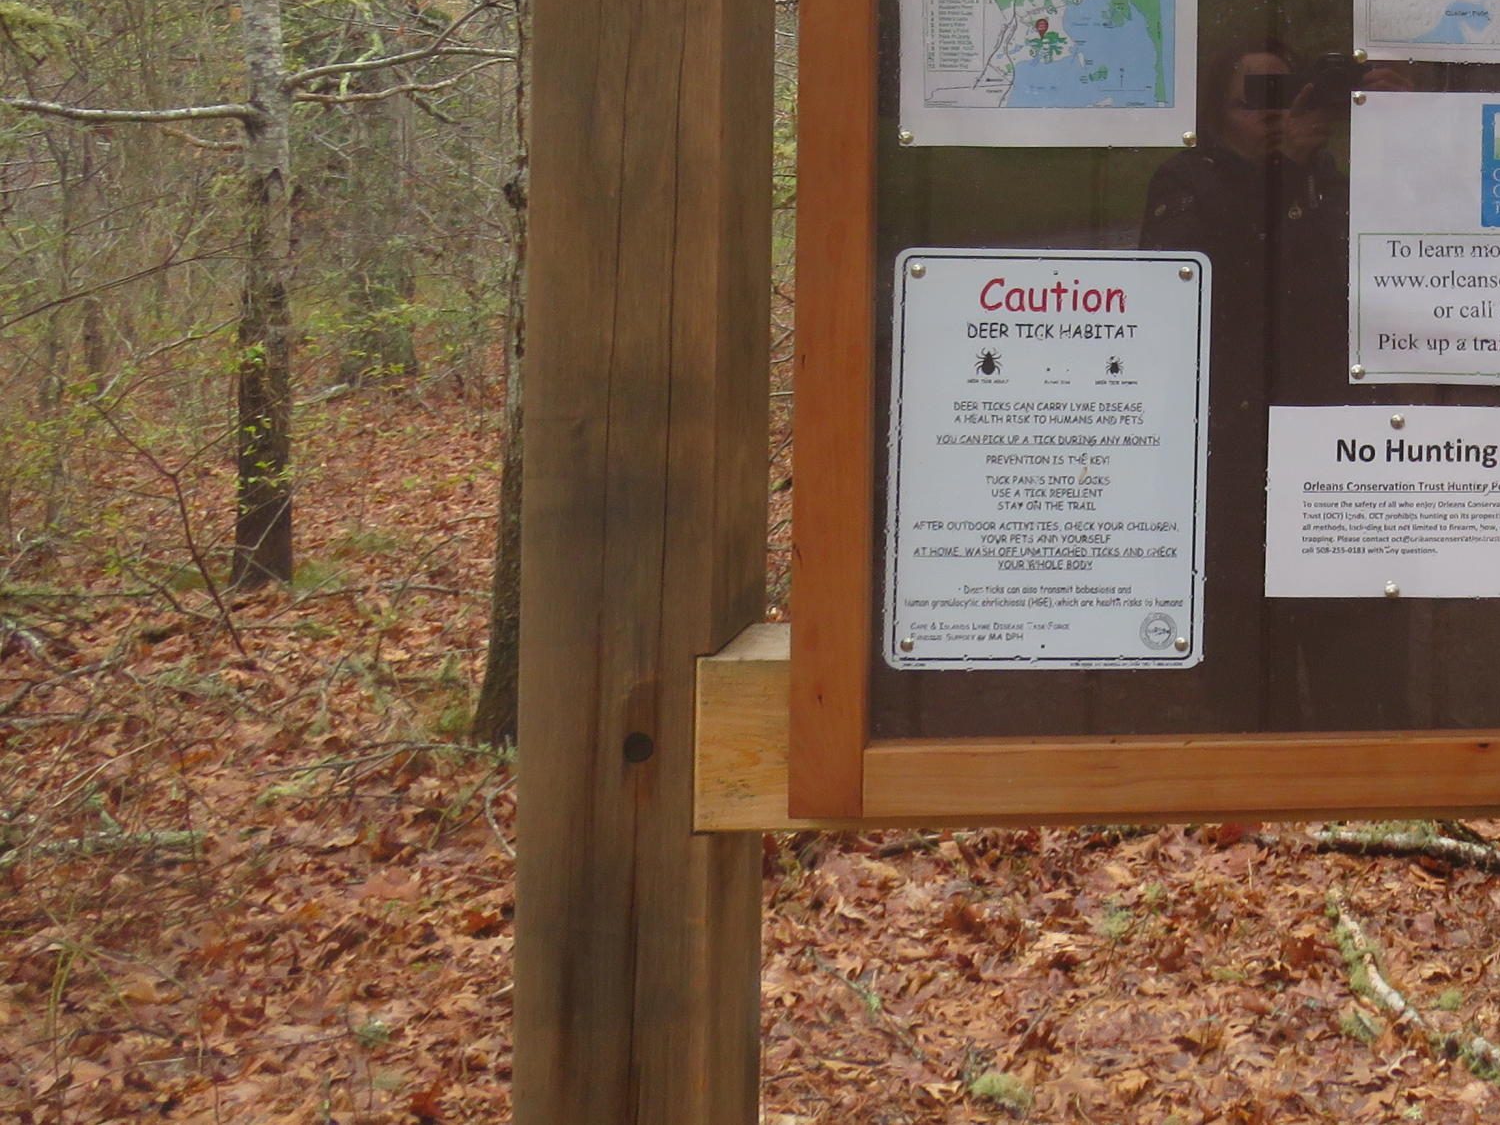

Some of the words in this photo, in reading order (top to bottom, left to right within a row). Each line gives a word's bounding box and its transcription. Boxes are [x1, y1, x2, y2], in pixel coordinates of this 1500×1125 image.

[1387, 240, 1411, 258] To
[1419, 240, 1464, 258] learn
[980, 278, 1127, 314] Caution
[1433, 305, 1454, 319] or
[1460, 300, 1493, 319] call
[967, 323, 1009, 340] DEER
[1016, 323, 1054, 340] TICK
[1059, 323, 1138, 340] HABITAT
[1378, 334, 1418, 351] Pick
[1427, 338, 1449, 355] up
[1456, 339, 1466, 351] a
[953, 401, 978, 412] DEER
[981, 401, 1011, 412] TICKS
[1013, 401, 1034, 412] CAN
[1036, 401, 1067, 412] CARRY
[1070, 401, 1096, 412] LYME
[1098, 401, 1145, 412] DISEASE,
[954, 414, 961, 425] A
[964, 414, 1003, 425] HEALTH
[1006, 414, 1030, 425] RISK
[1034, 414, 1047, 425] TO
[1049, 414, 1093, 425] HUMANS
[1096, 414, 1117, 425] AND
[1120, 414, 1144, 425] PETS
[936, 434, 957, 445] YOU
[960, 434, 981, 445] CAN
[983, 434, 1006, 445] PICK
[1007, 434, 1019, 445] UP
[1023, 434, 1029, 445] A
[1032, 434, 1055, 445] TICK
[1058, 434, 1097, 445] DURING
[1100, 434, 1120, 445] ANY
[1123, 434, 1160, 445] MONTH
[1336, 439, 1376, 462] No
[1386, 438, 1498, 468] Hunting
[986, 455, 1050, 465] PREVENTION
[1052, 455, 1064, 465] IS
[1068, 455, 1088, 465] THE
[986, 475, 1010, 485] TUCK
[1048, 475, 1075, 485] INTO
[991, 488, 1011, 498] USE
[1014, 488, 1021, 498] A
[1024, 488, 1047, 498] TICK
[1049, 488, 1103, 498] REPELLENT
[1303, 482, 1343, 492] Orleans
[1346, 482, 1415, 492] Conservation
[1418, 482, 1444, 492] Trust
[1447, 481, 1489, 495] Hunting
[997, 501, 1023, 511] STAY
[1026, 501, 1041, 511] ON
[1045, 501, 1064, 511] THE
[1067, 501, 1096, 511] TRAIL
[913, 521, 944, 532] AFTER
[947, 521, 996, 532] OUTDOOR
[1064, 521, 1095, 532] CHECK
[1098, 521, 1124, 532] YOUR
[980, 534, 1007, 544] YOUR
[1010, 534, 1034, 544] PETS
[1037, 534, 1058, 544] AND
[1061, 534, 1111, 544] YOURSELF
[913, 547, 927, 557] AT
[965, 547, 995, 557] WASH
[998, 547, 1018, 557] OFF
[1020, 547, 1087, 557] UNATTACHED
[1091, 547, 1120, 557] TICKS
[1123, 547, 1144, 557] AND
[1146, 547, 1177, 557] CHECK
[998, 559, 1024, 570] YOUR
[1027, 559, 1063, 570] WHOLE
[1066, 559, 1093, 570] BODY
[1007, 585, 1020, 594] can
[1040, 585, 1073, 594] transmit
[1117, 585, 1132, 594] and
[1080, 599, 1094, 607] are
[1123, 599, 1141, 607] risks
[989, 633, 1002, 641] MA
[1005, 633, 1024, 641] DPH
